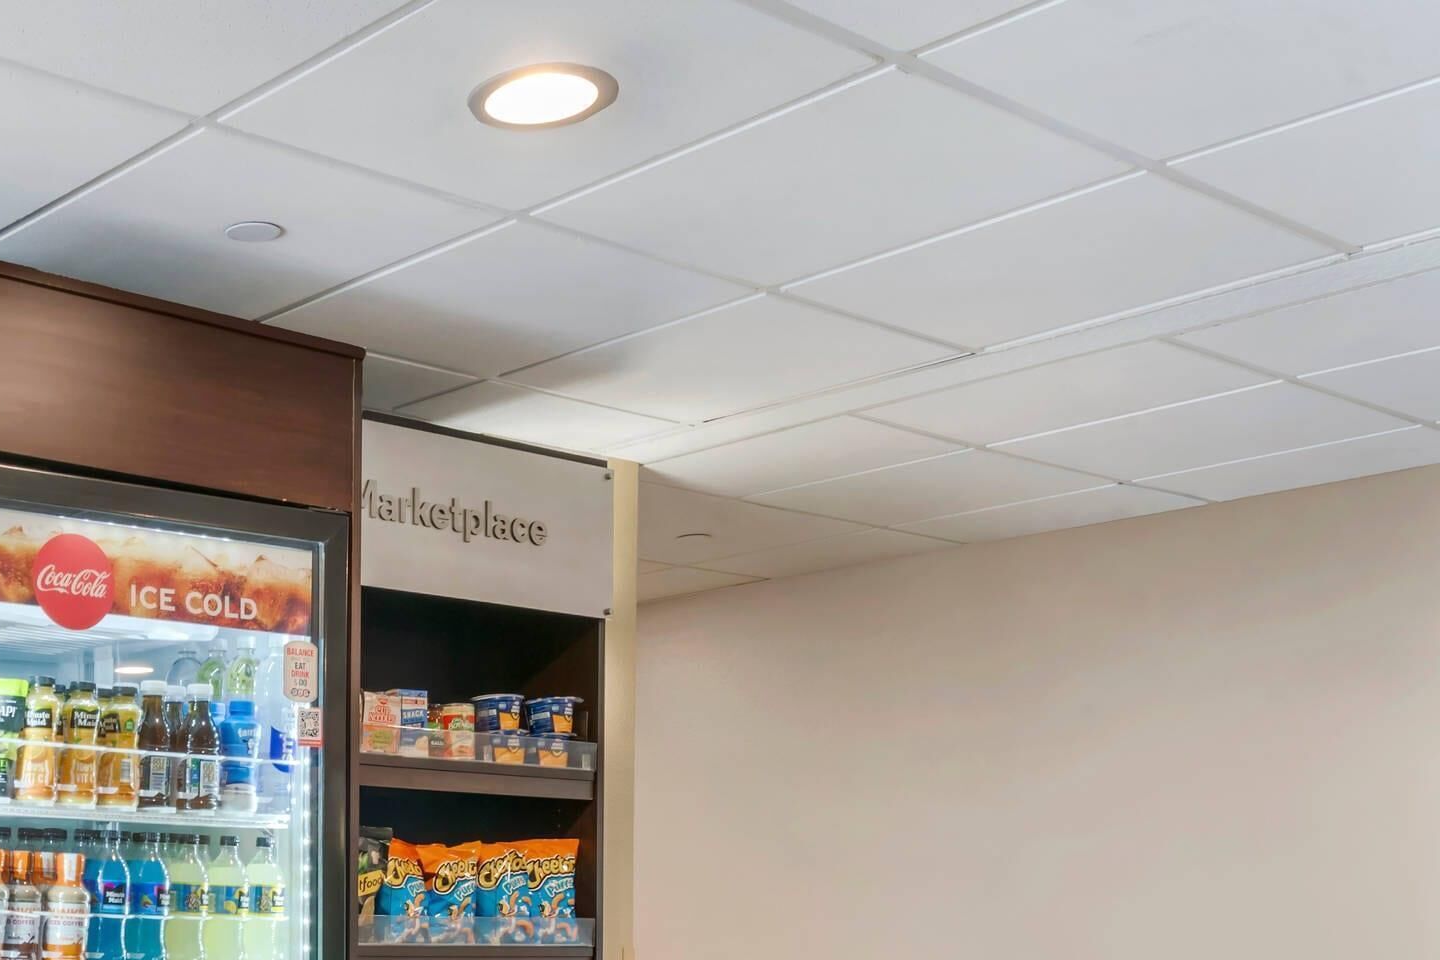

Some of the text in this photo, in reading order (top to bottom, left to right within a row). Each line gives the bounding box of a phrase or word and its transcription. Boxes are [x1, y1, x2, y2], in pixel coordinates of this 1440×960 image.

[36, 563, 112, 599] Coca-Cola
[129, 583, 258, 621] ICE COLD
[286, 646, 315, 658] BALANCE
[294, 661, 307, 670] EAT
[291, 669, 310, 679] DRINK
[359, 875, 384, 892] tfood
